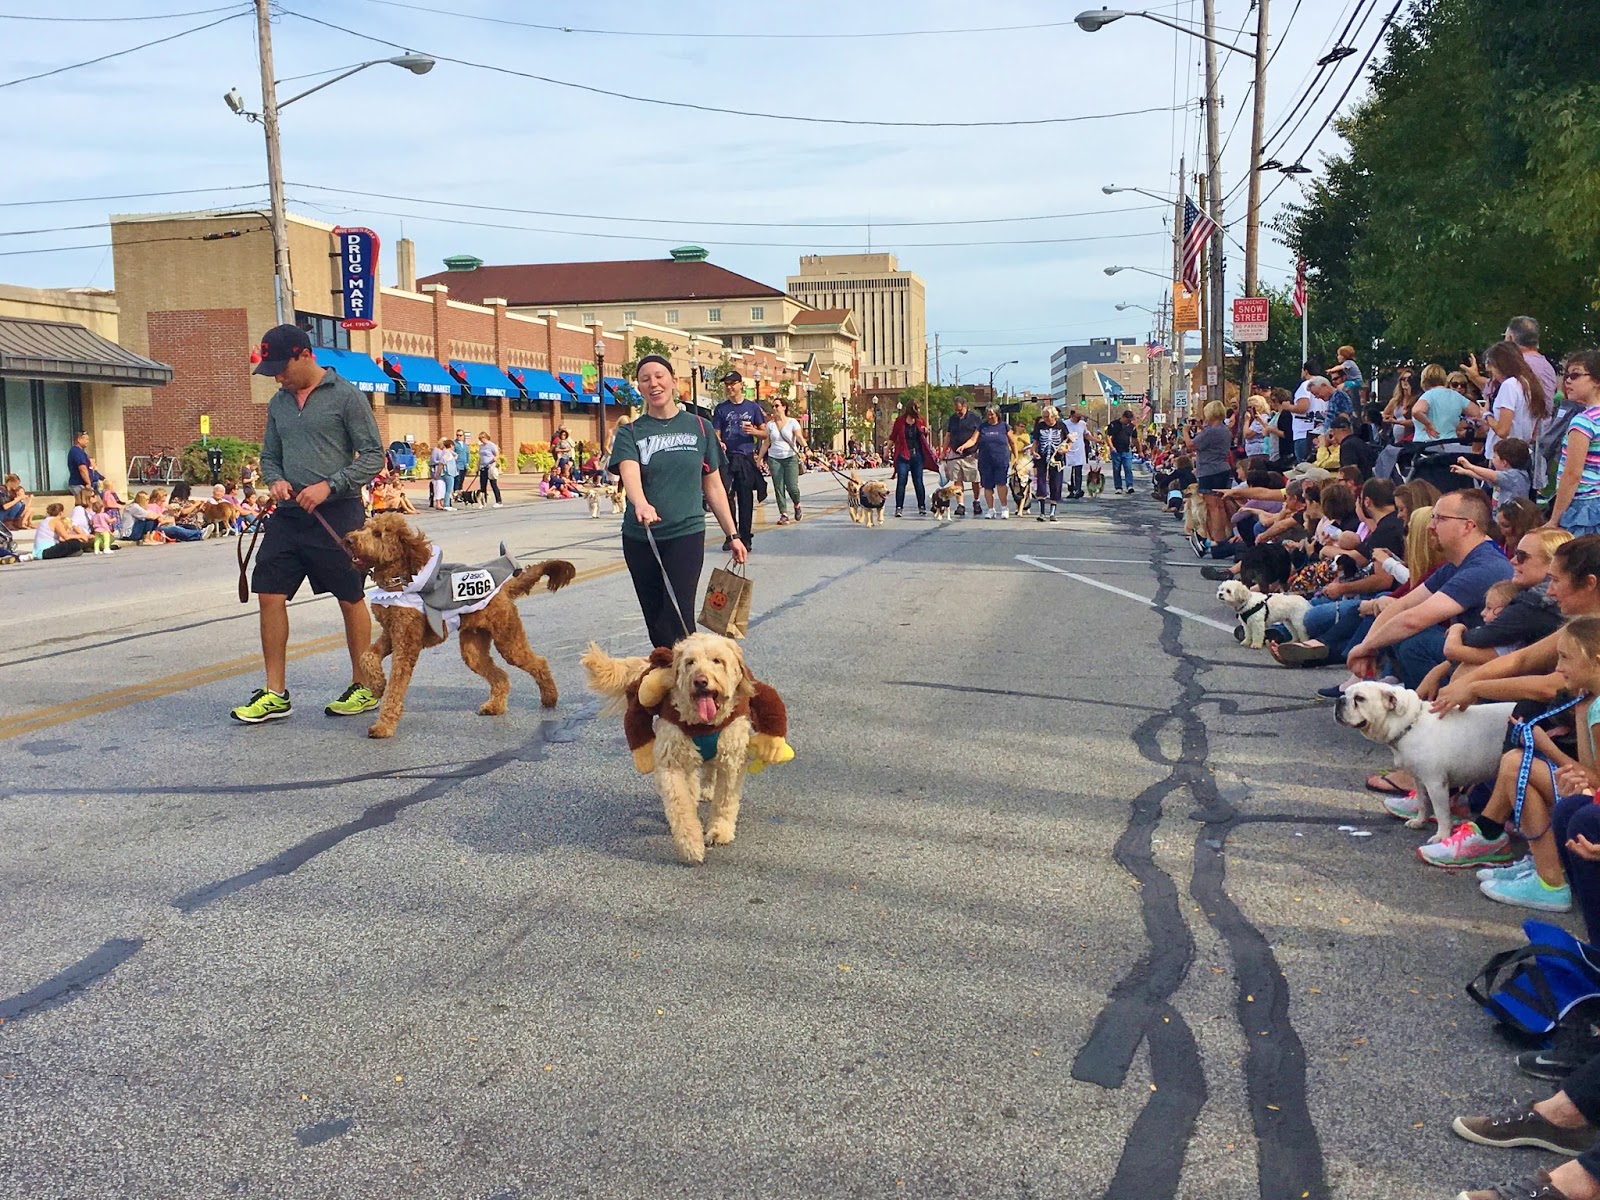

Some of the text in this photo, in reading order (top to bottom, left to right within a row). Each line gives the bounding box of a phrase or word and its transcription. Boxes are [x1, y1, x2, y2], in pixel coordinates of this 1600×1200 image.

[347, 235, 362, 273] DRUG
[349, 279, 364, 317] MART
[1238, 305, 1264, 314] SNOW
[1235, 314, 1267, 322] STREET
[261, 342, 269, 357] C
[359, 382, 374, 391] DRUG
[375, 382, 389, 392] MART
[418, 383, 451, 393] FOOD MARKET
[636, 434, 698, 465] VIKINGS
[457, 579, 491, 597] 2566
